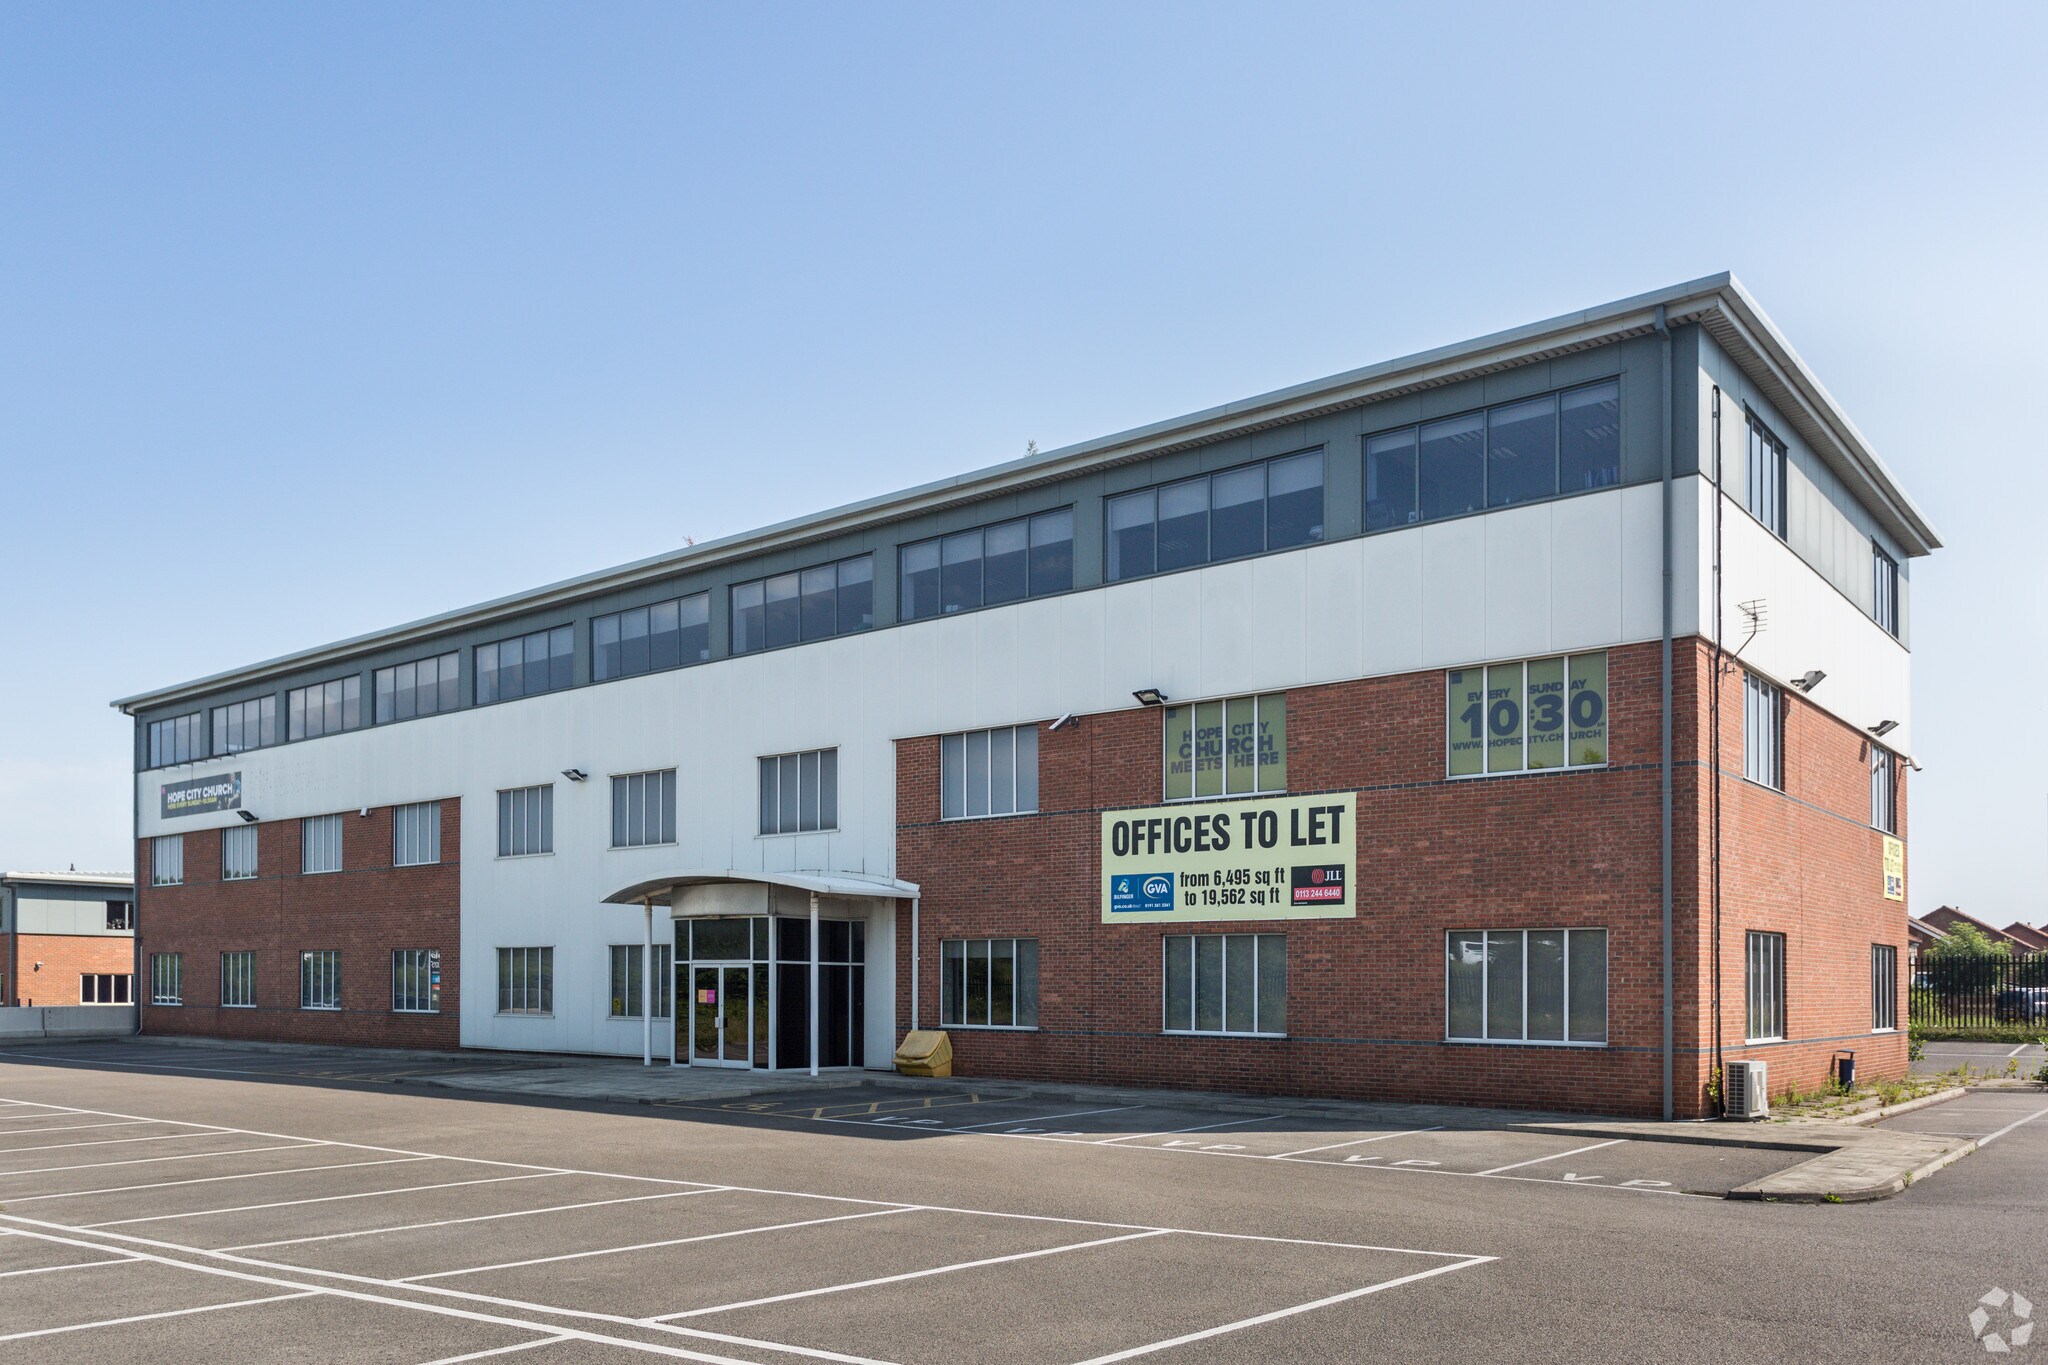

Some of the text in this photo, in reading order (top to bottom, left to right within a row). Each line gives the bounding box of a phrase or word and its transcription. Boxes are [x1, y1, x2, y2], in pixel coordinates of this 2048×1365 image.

[1468, 679, 1587, 702] EVERY SUNDAY
[1460, 690, 1603, 739] 10:30
[1183, 721, 1269, 742] HOPE CITY
[1452, 729, 1602, 751] WWW.HOPECITY.CHURCH
[1179, 734, 1273, 759] CHURCH
[1171, 757, 1223, 774] MEETS
[1234, 751, 1279, 768] HERE
[167, 783, 233, 804] HOPE CITY CHURCH
[1112, 805, 1346, 857] OFFICES TO LET
[1180, 867, 1285, 888] from 6,495 sq ft
[1324, 870, 1342, 881] JLL
[1147, 883, 1168, 894] GVA
[1184, 887, 1280, 908] to 19,562 sq ft
[1295, 888, 1341, 898] 0113 244 6440
